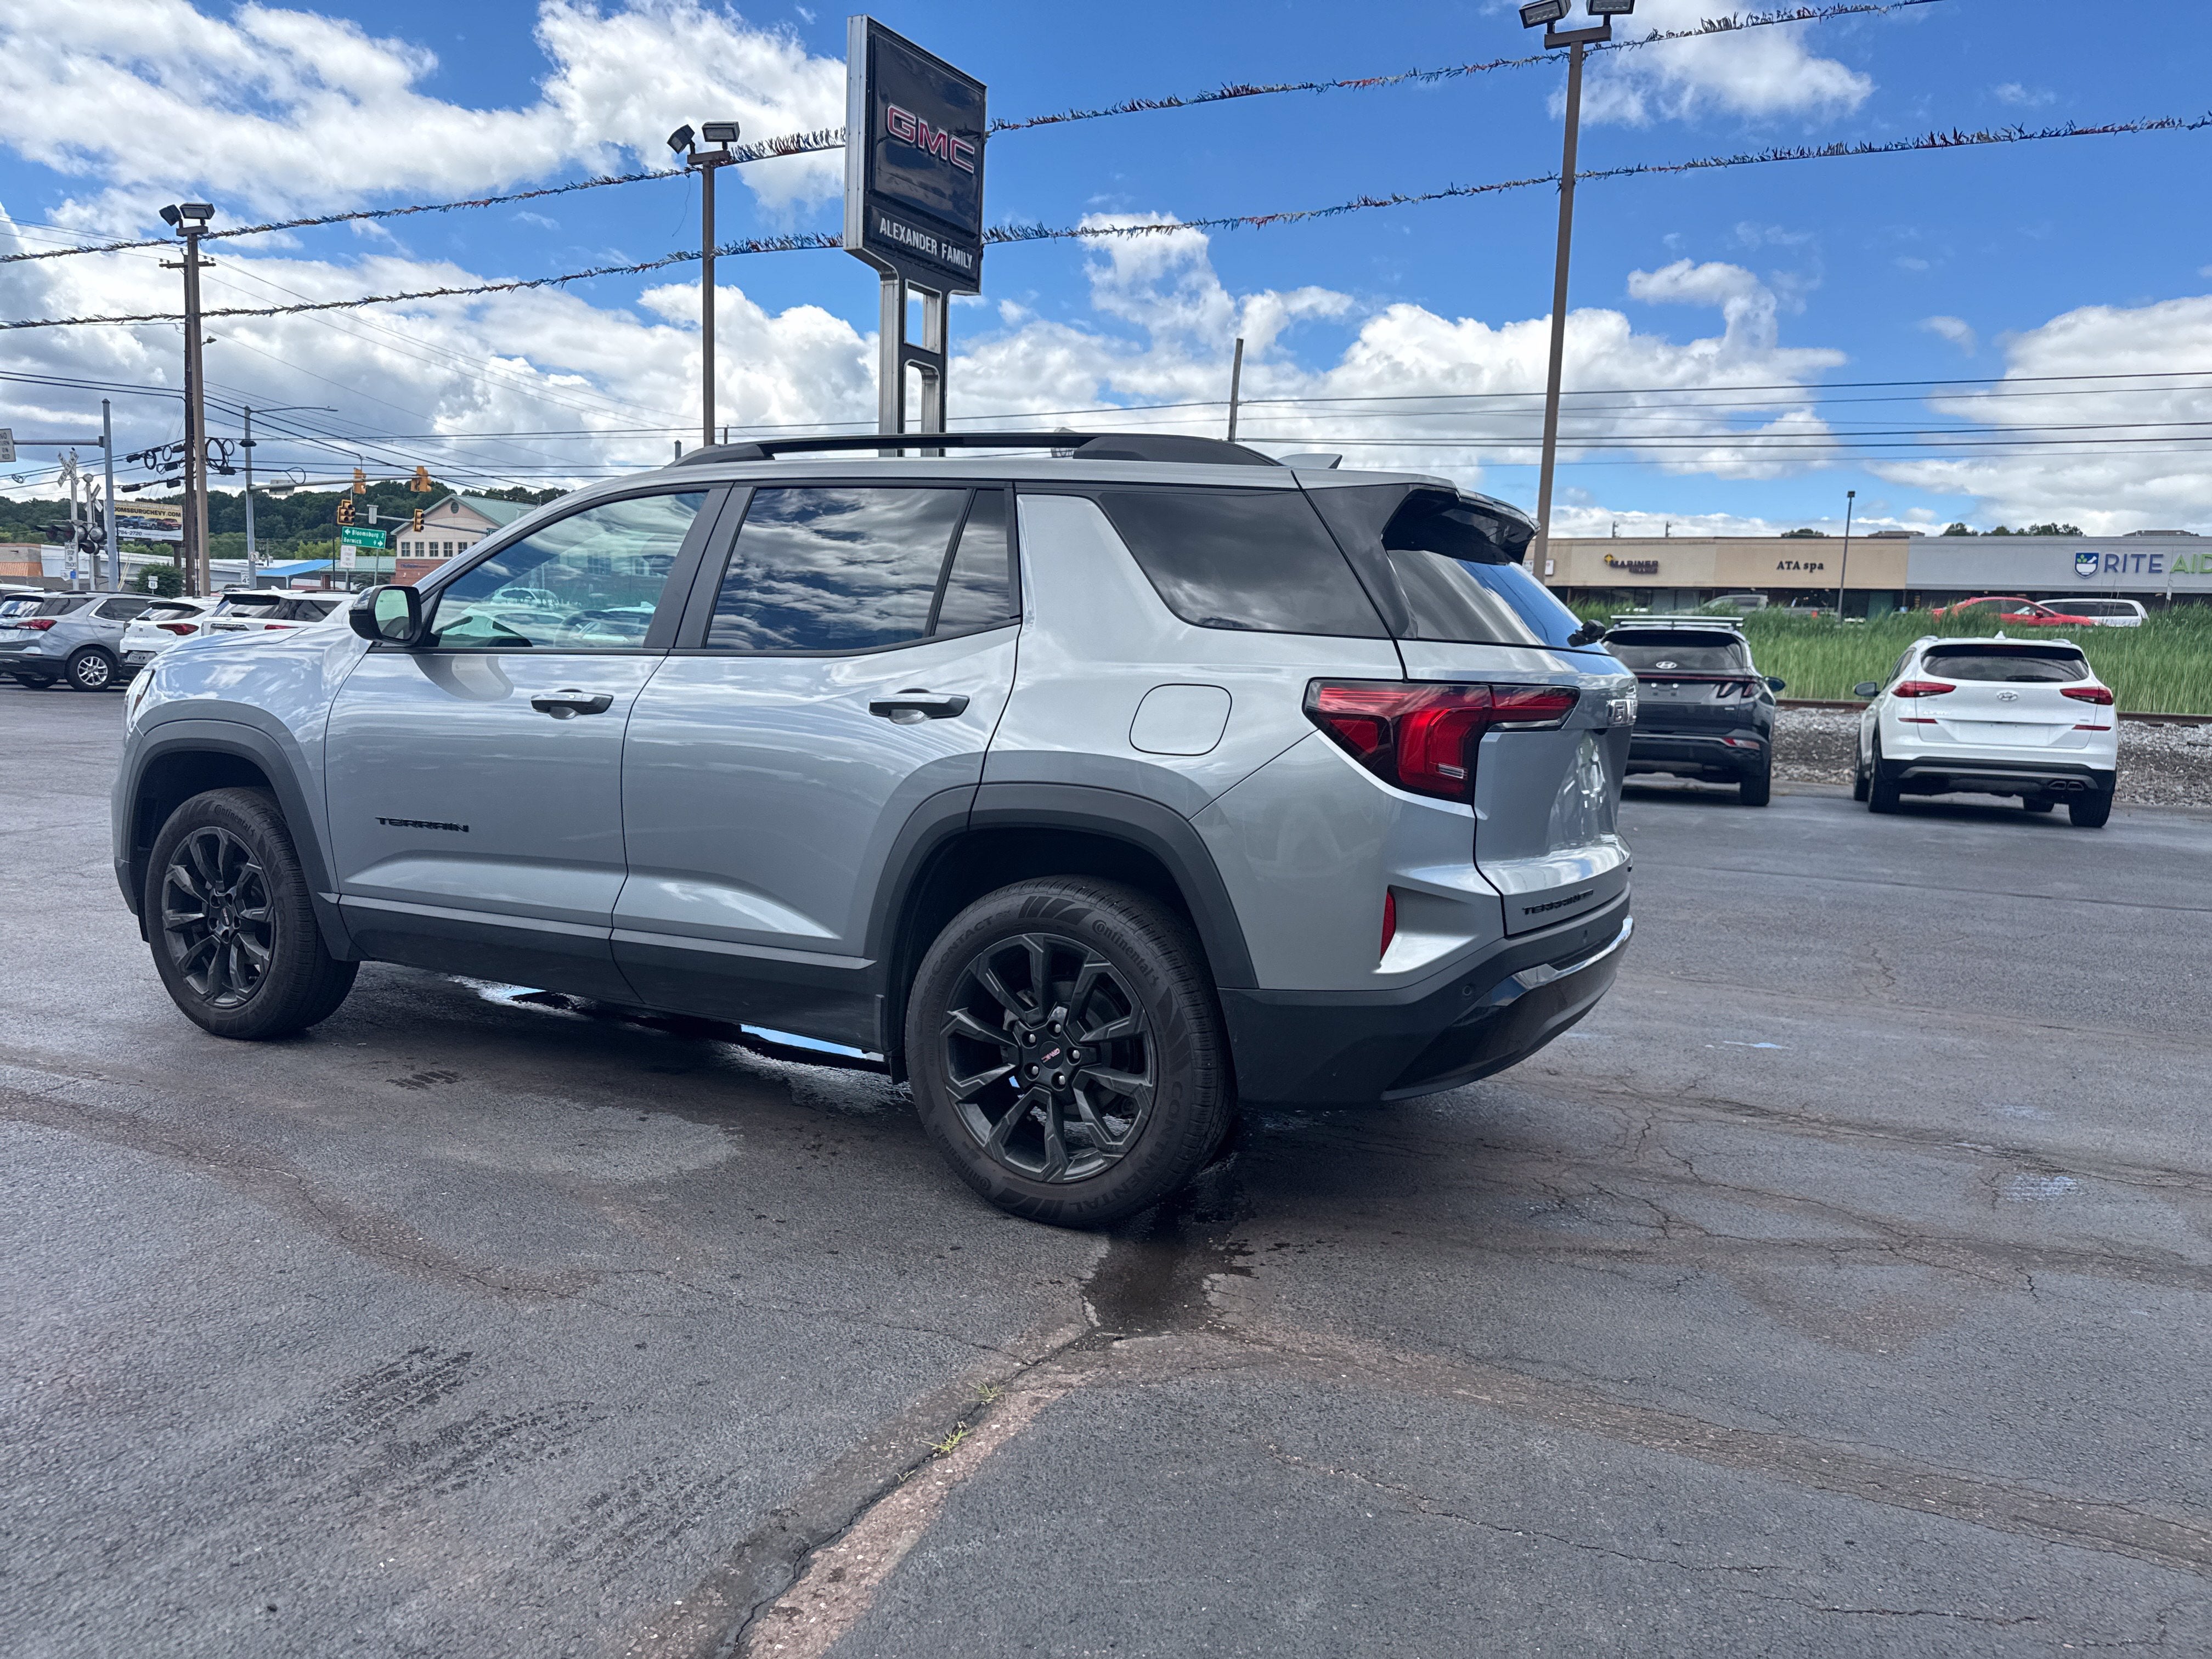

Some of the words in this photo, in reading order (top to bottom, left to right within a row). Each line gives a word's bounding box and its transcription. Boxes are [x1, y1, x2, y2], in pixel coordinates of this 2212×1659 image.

[887, 103, 975, 175] GMC
[879, 217, 937, 256] ALEXANDER
[941, 243, 973, 270] FAMILY
[352, 529, 379, 539] Bloomsburg
[1610, 560, 1658, 568] MARINER
[1776, 560, 1801, 570] ATA
[1803, 562, 1824, 573] spa
[2103, 554, 2164, 573] RITE
[2169, 554, 2212, 574] AID
[375, 816, 470, 832] TERRAIN
